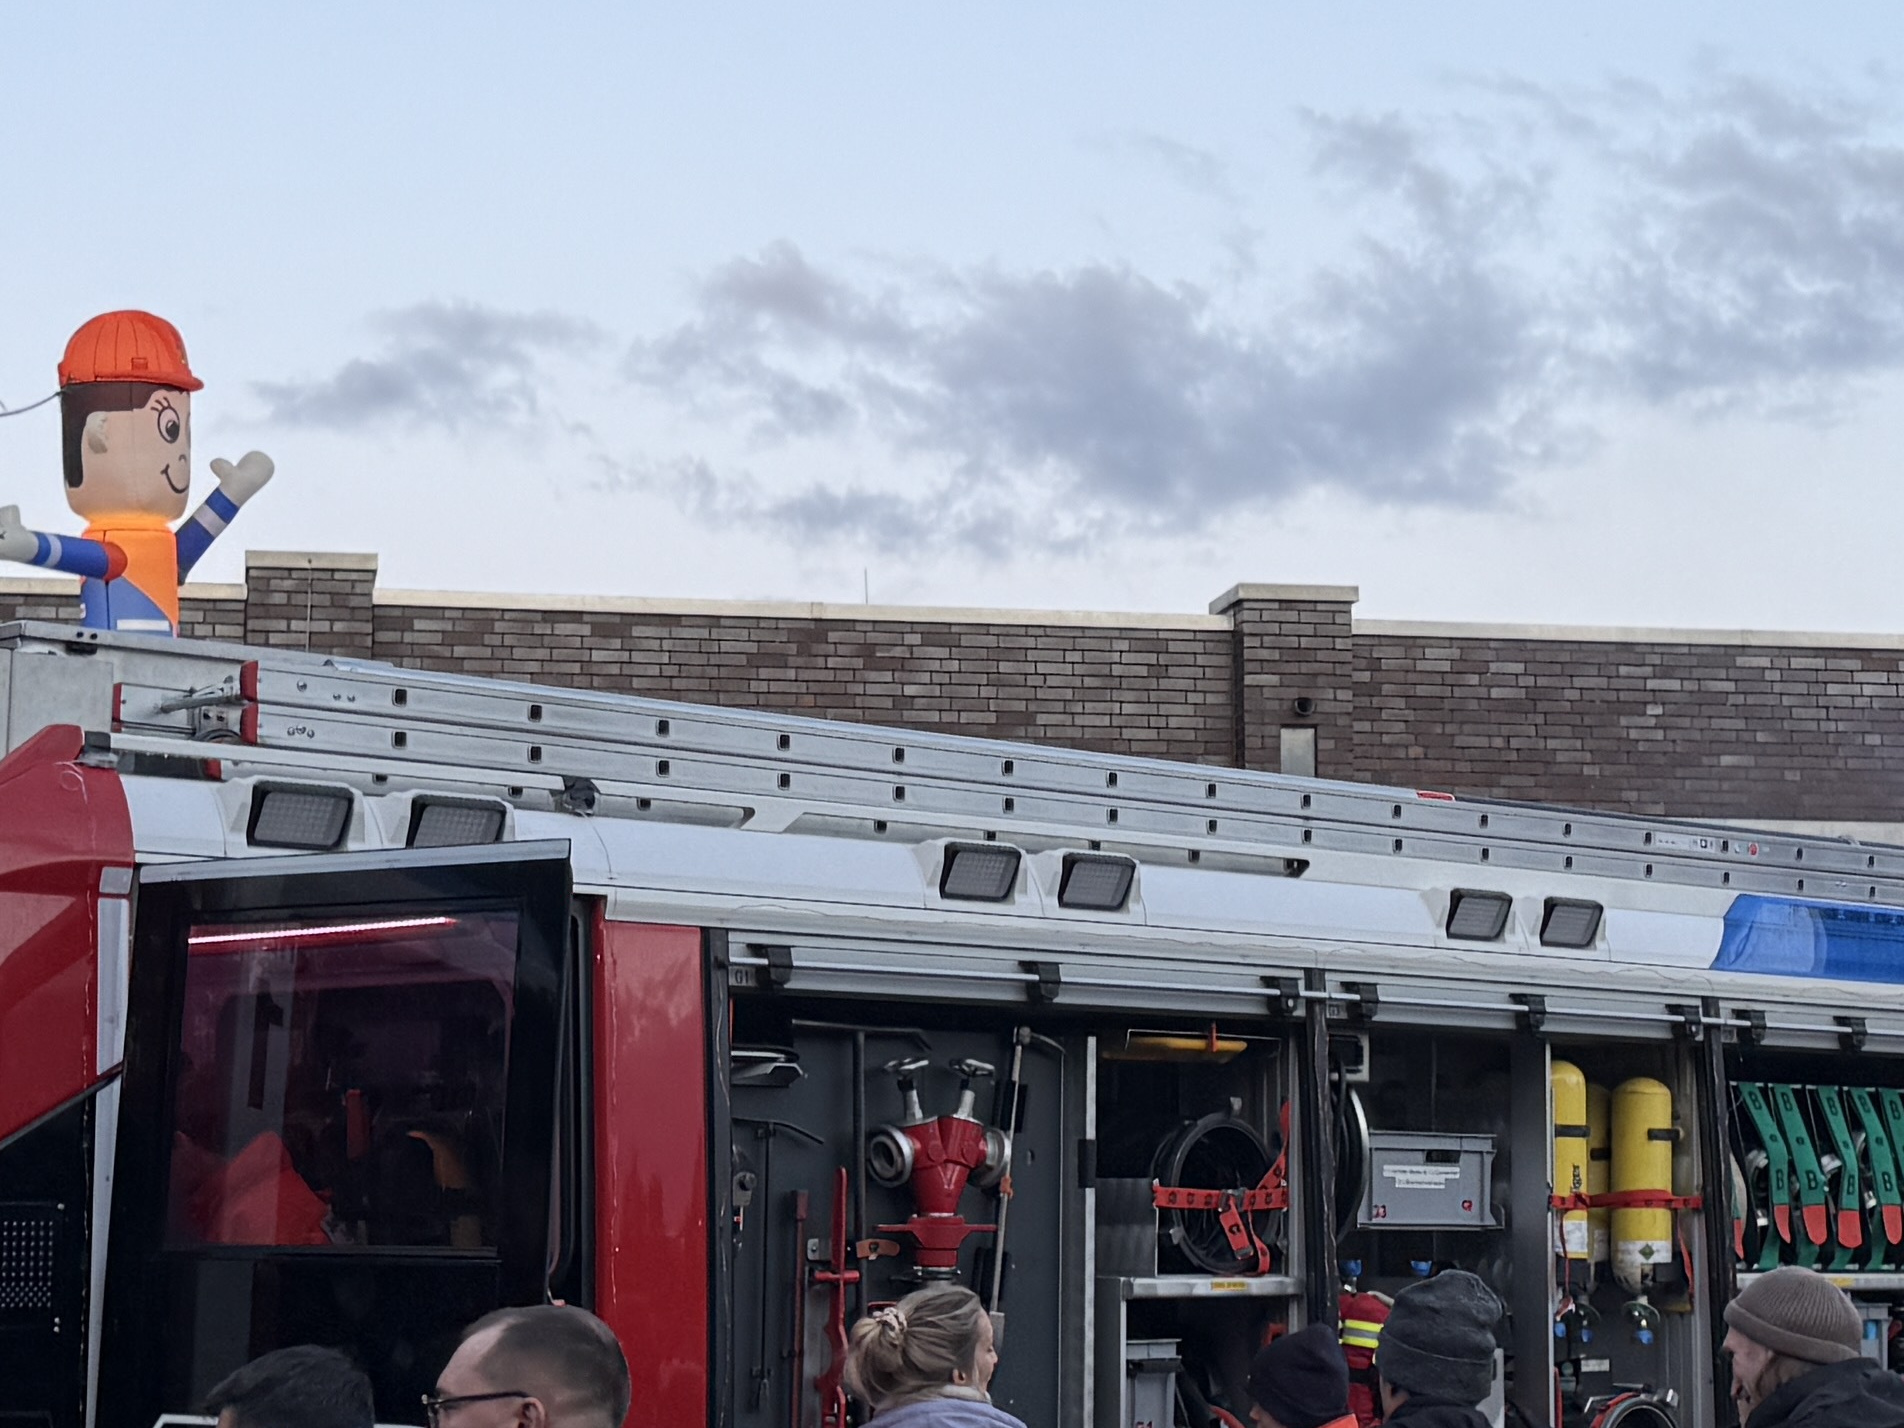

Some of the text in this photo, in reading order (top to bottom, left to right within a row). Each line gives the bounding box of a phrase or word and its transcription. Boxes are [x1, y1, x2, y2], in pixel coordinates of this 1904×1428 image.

[1777, 1168, 1785, 1191] B
[1805, 1169, 1818, 1191] B
[1847, 1174, 1856, 1195] B
[1882, 1171, 1893, 1192] B
